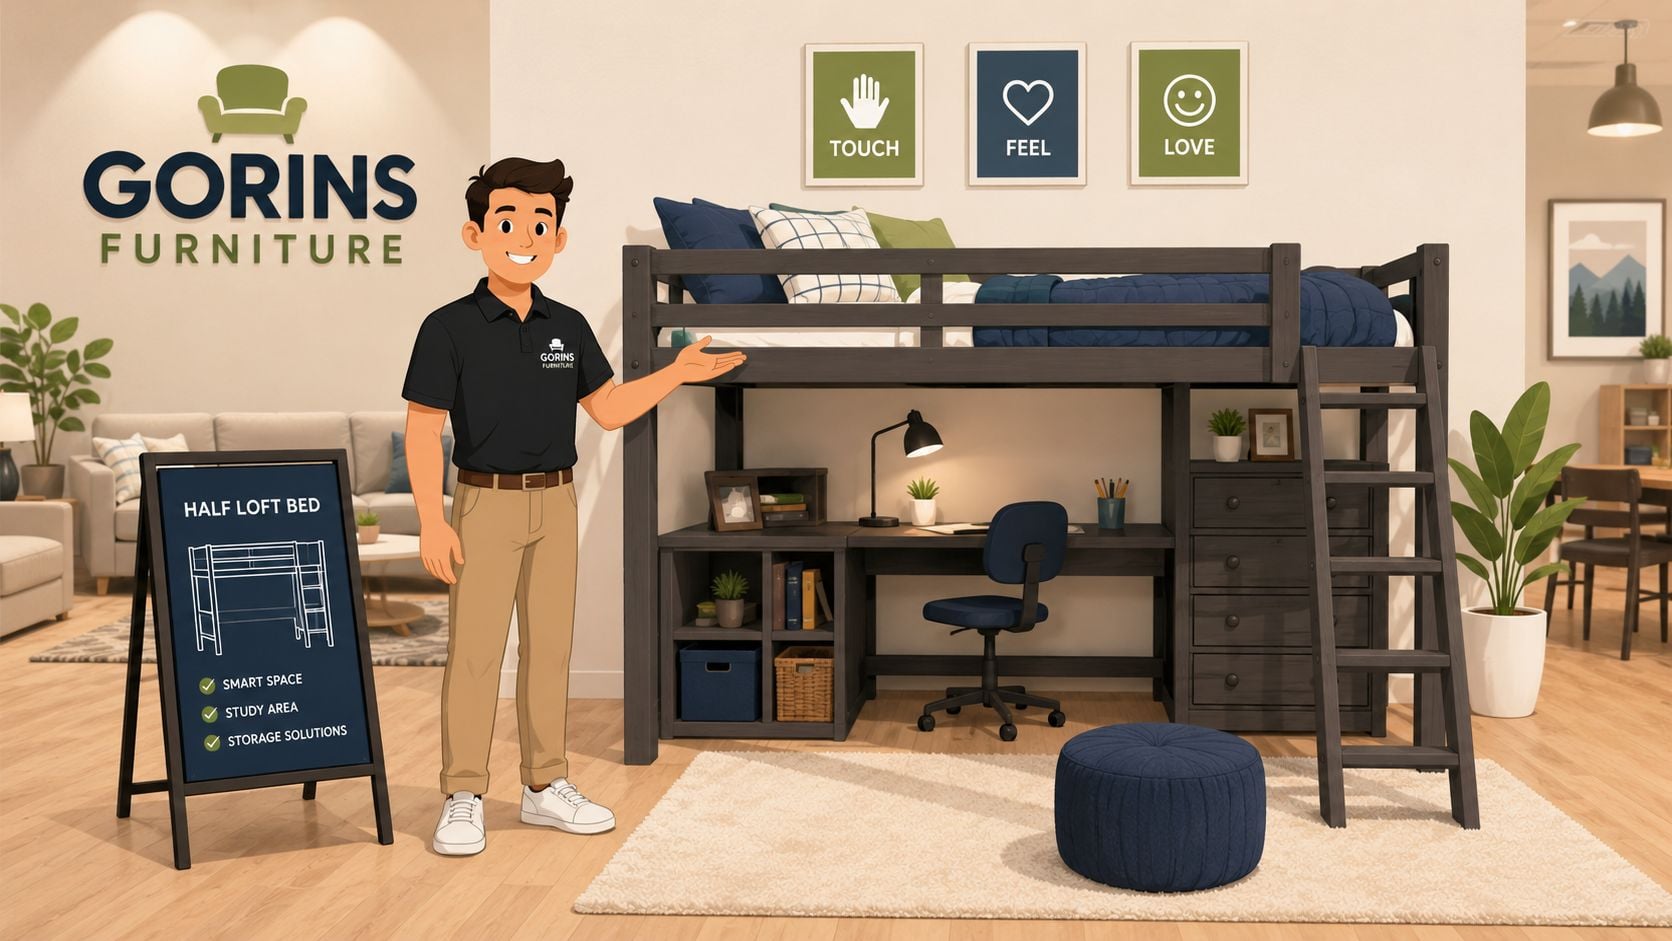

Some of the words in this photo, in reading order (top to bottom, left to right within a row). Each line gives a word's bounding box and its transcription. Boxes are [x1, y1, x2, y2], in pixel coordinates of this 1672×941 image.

[830, 139, 899, 157] TOUCH
[1006, 139, 1051, 156] FEEL
[1164, 138, 1215, 156] LOVE
[83, 150, 418, 220] GORINS
[101, 233, 402, 264] FURNITURE
[540, 352, 575, 362] GORINS
[184, 500, 231, 517] HALF
[236, 499, 281, 515] LOFT
[286, 498, 321, 513] BED
[222, 676, 263, 690] SMART
[266, 673, 303, 687] SPACE
[225, 705, 264, 719] STUDY
[267, 701, 299, 715] AREA
[228, 731, 282, 747] STORAGE
[284, 725, 348, 741] SOLUTIONS
